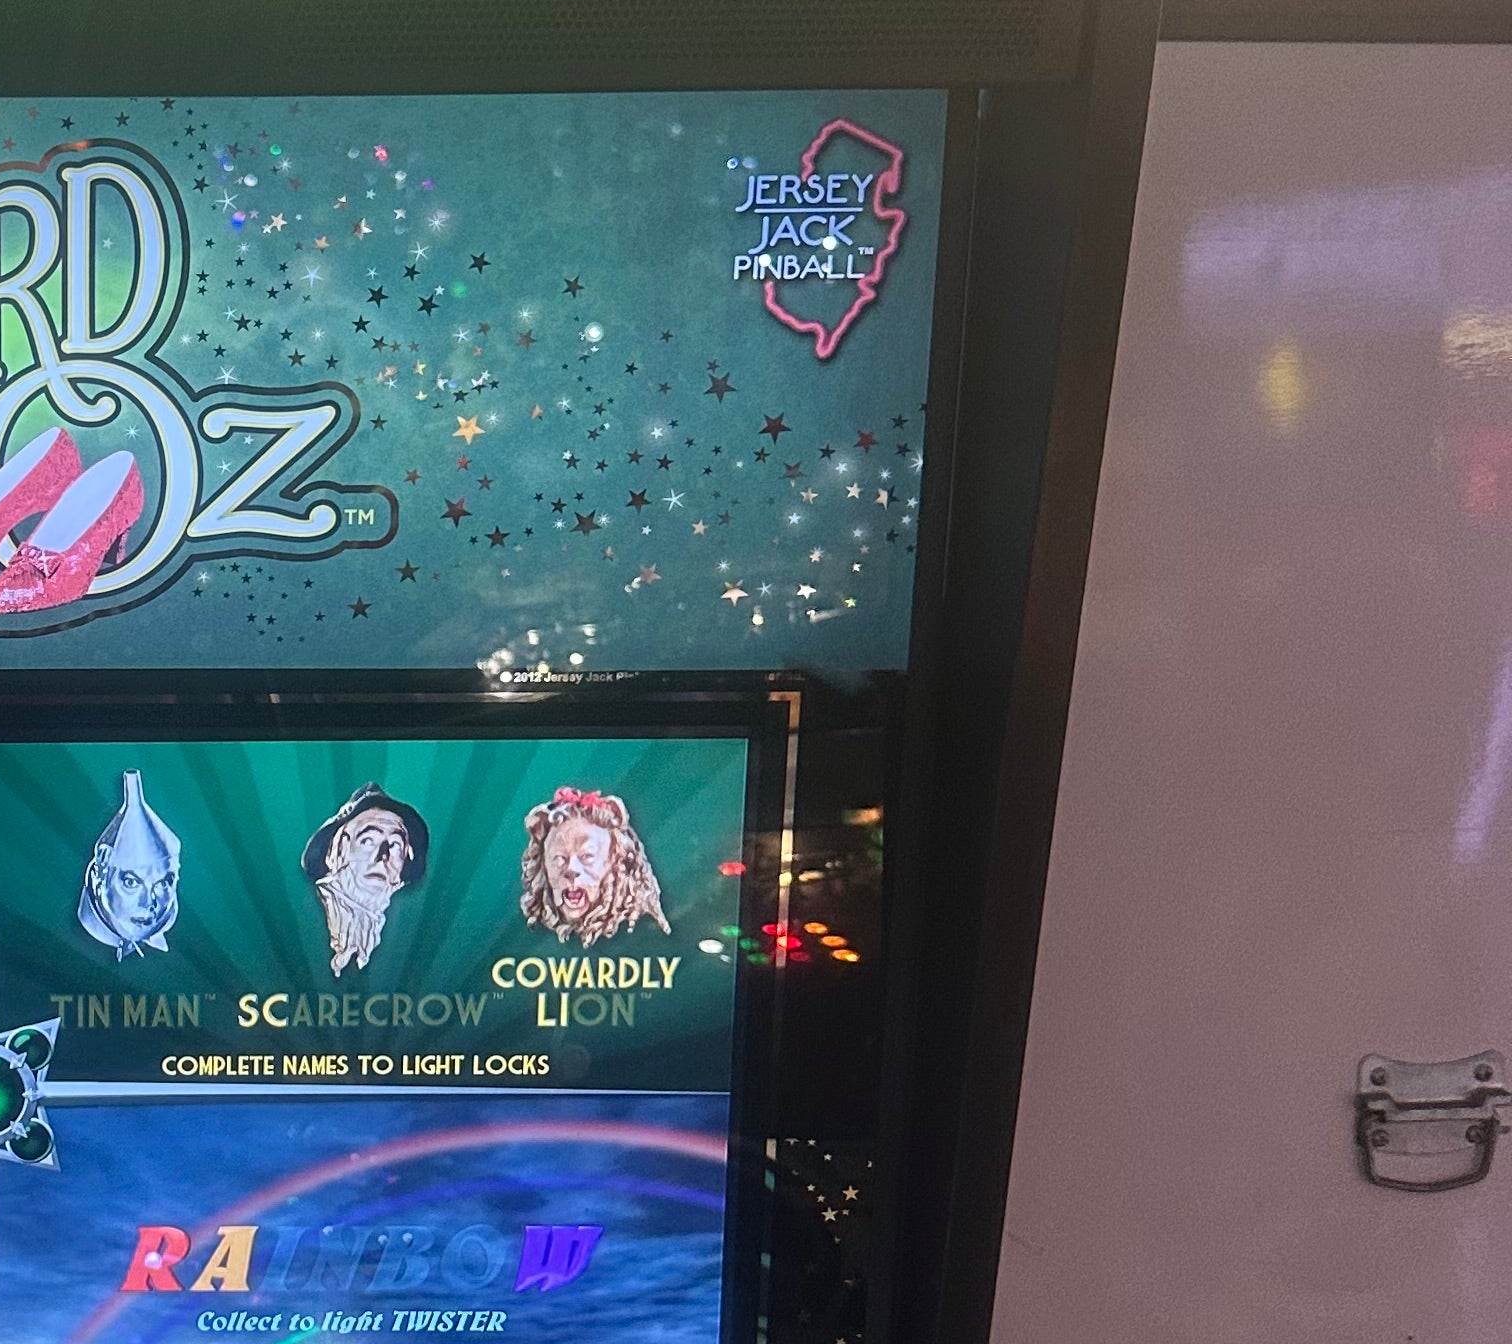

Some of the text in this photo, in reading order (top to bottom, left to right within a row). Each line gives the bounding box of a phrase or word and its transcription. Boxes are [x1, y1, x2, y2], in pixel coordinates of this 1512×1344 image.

[735, 173, 874, 213] JERSEY
[748, 214, 856, 255] JACK
[513, 671, 541, 683] 2012
[544, 671, 583, 686] Jersey
[585, 671, 614, 683] Jack
[491, 957, 682, 990] COWARDLY
[50, 994, 112, 1029] TIN
[161, 1054, 550, 1077] COMPLETE NAMES TO LIGHT LOCKS
[119, 1224, 604, 1293] RAINBOW
[196, 1309, 507, 1335] Collect to light TWISTER
